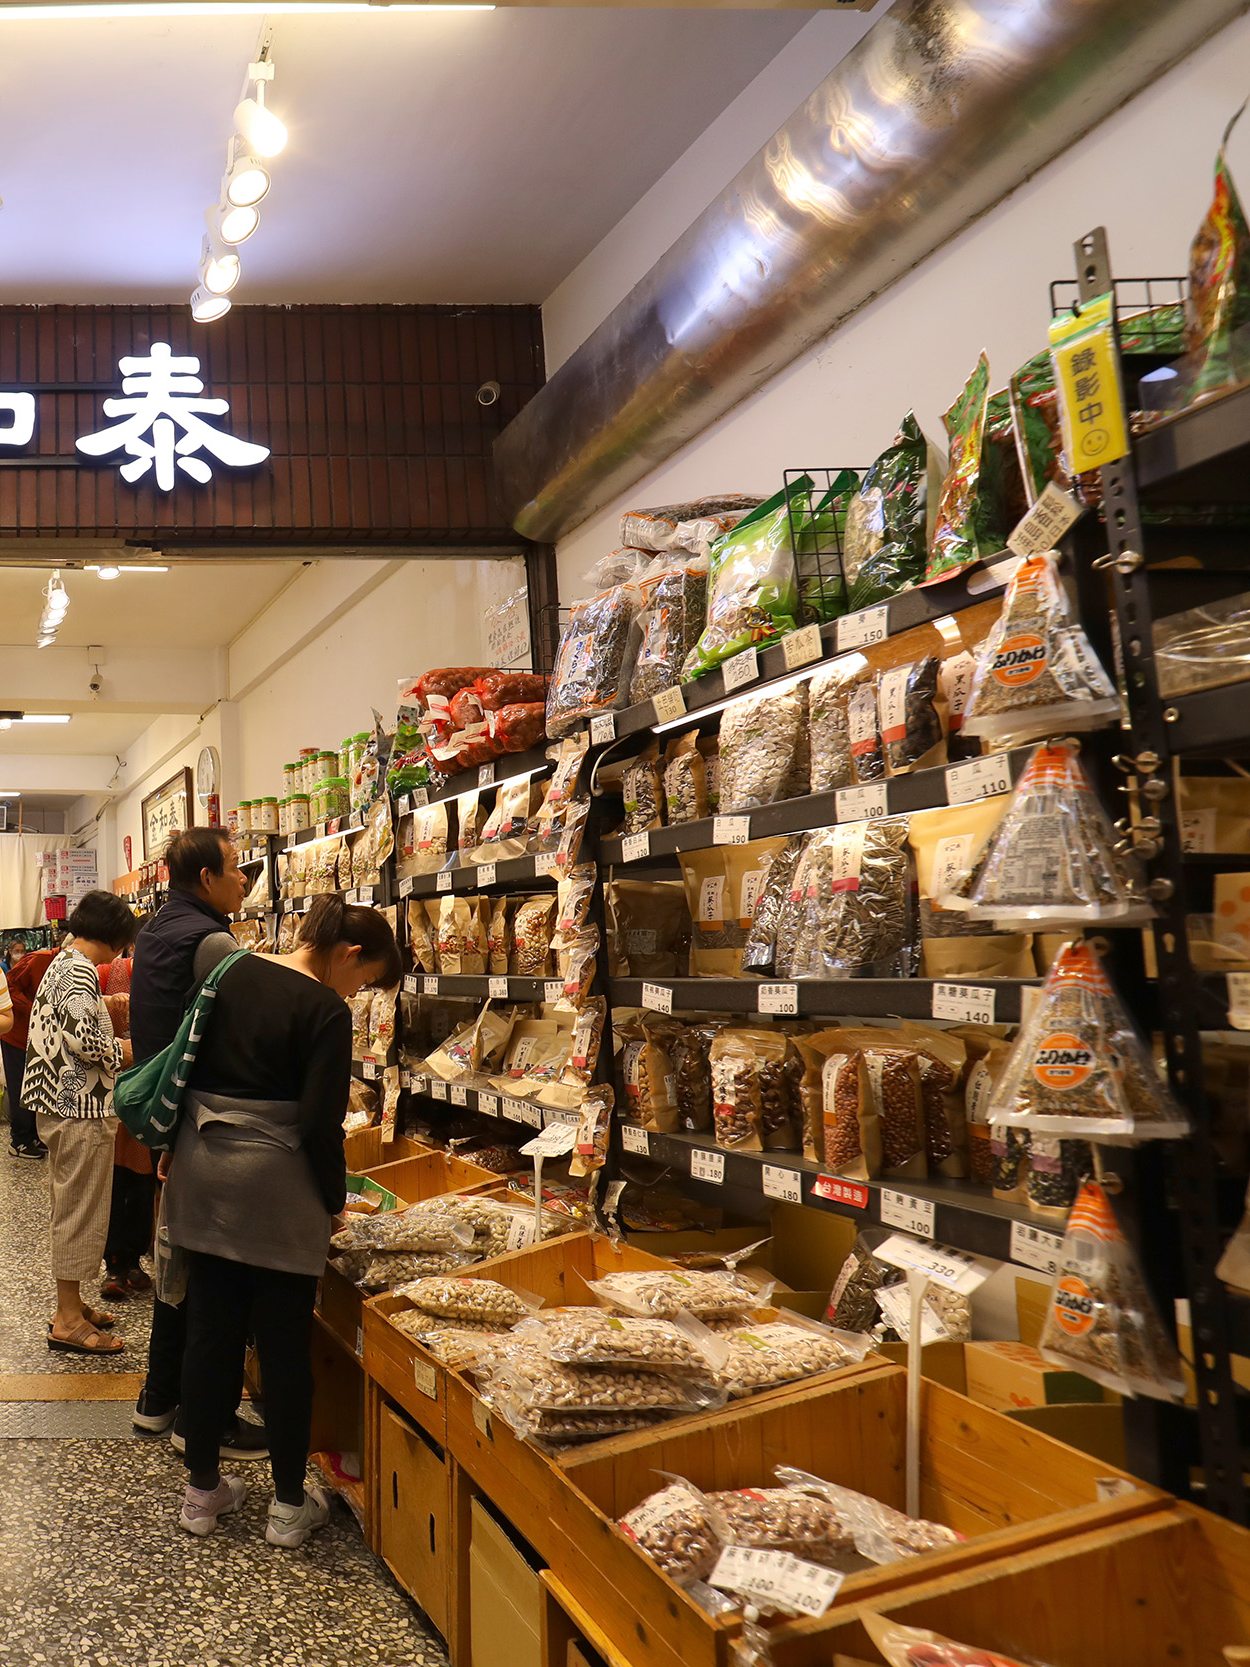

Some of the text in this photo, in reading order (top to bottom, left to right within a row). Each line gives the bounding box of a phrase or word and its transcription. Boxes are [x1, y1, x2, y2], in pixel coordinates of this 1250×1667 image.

[1070, 346, 1103, 425] 錄影中
[863, 629, 883, 643] 150
[953, 673, 967, 711] 黑瓜子
[951, 756, 1007, 782] 白瓜子
[981, 779, 1007, 796] 110
[863, 806, 884, 818] 100
[716, 817, 749, 827] 白瓜子
[731, 834, 746, 844] 190
[636, 848, 648, 859] 120
[657, 1003, 670, 1013] 140
[778, 1003, 794, 1013] 100
[965, 1011, 991, 1024] 140
[636, 1145, 648, 1155] 130
[709, 1169, 723, 1180] 180
[782, 1189, 798, 1202] 180
[822, 1180, 863, 1203] 台灣製造
[910, 1220, 931, 1235] 100
[927, 1261, 956, 1278] 330
[794, 1592, 822, 1611] 100
